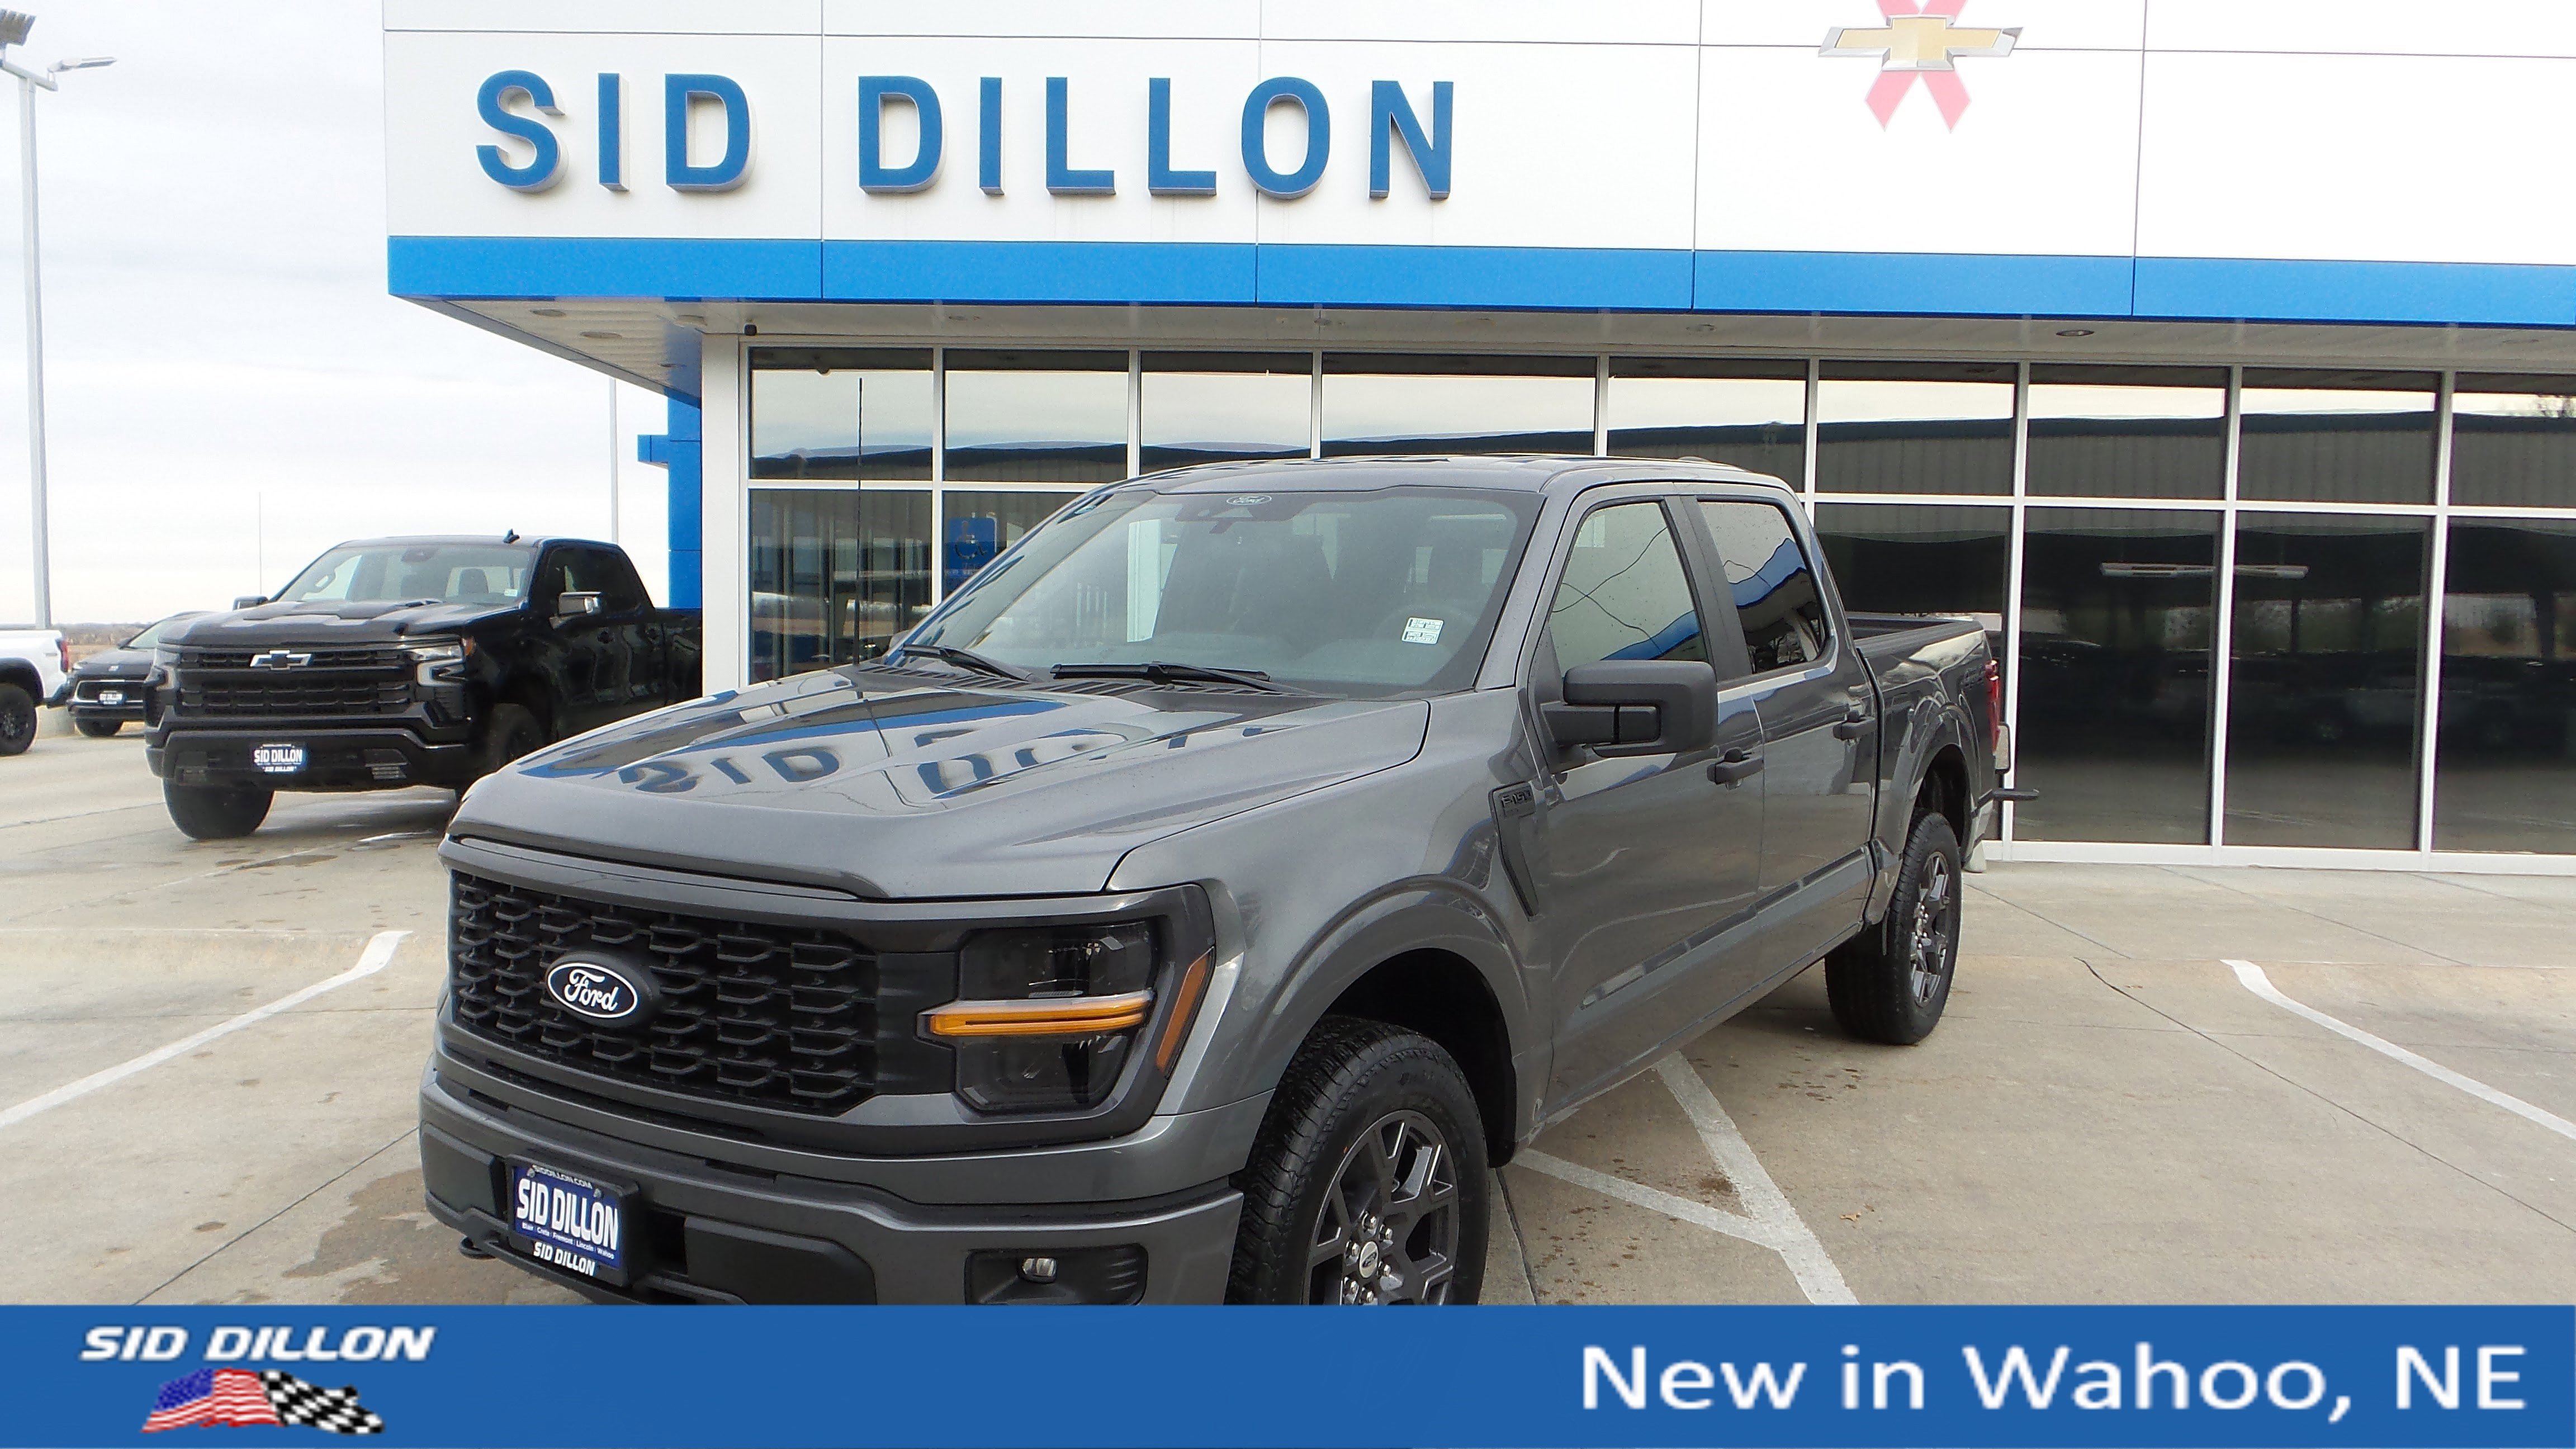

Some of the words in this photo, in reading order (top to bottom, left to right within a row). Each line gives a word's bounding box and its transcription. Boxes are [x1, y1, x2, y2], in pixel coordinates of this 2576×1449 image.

[476, 69, 756, 192] SID
[859, 76, 1453, 199] DILLON
[254, 750, 269, 763] SID
[271, 749, 302, 762] DILLON
[565, 969, 619, 1011] Ford
[517, 1178, 549, 1225] SID
[551, 1188, 618, 1250] DILLON
[533, 1242, 553, 1261] SID
[554, 1248, 596, 1276] DILLON
